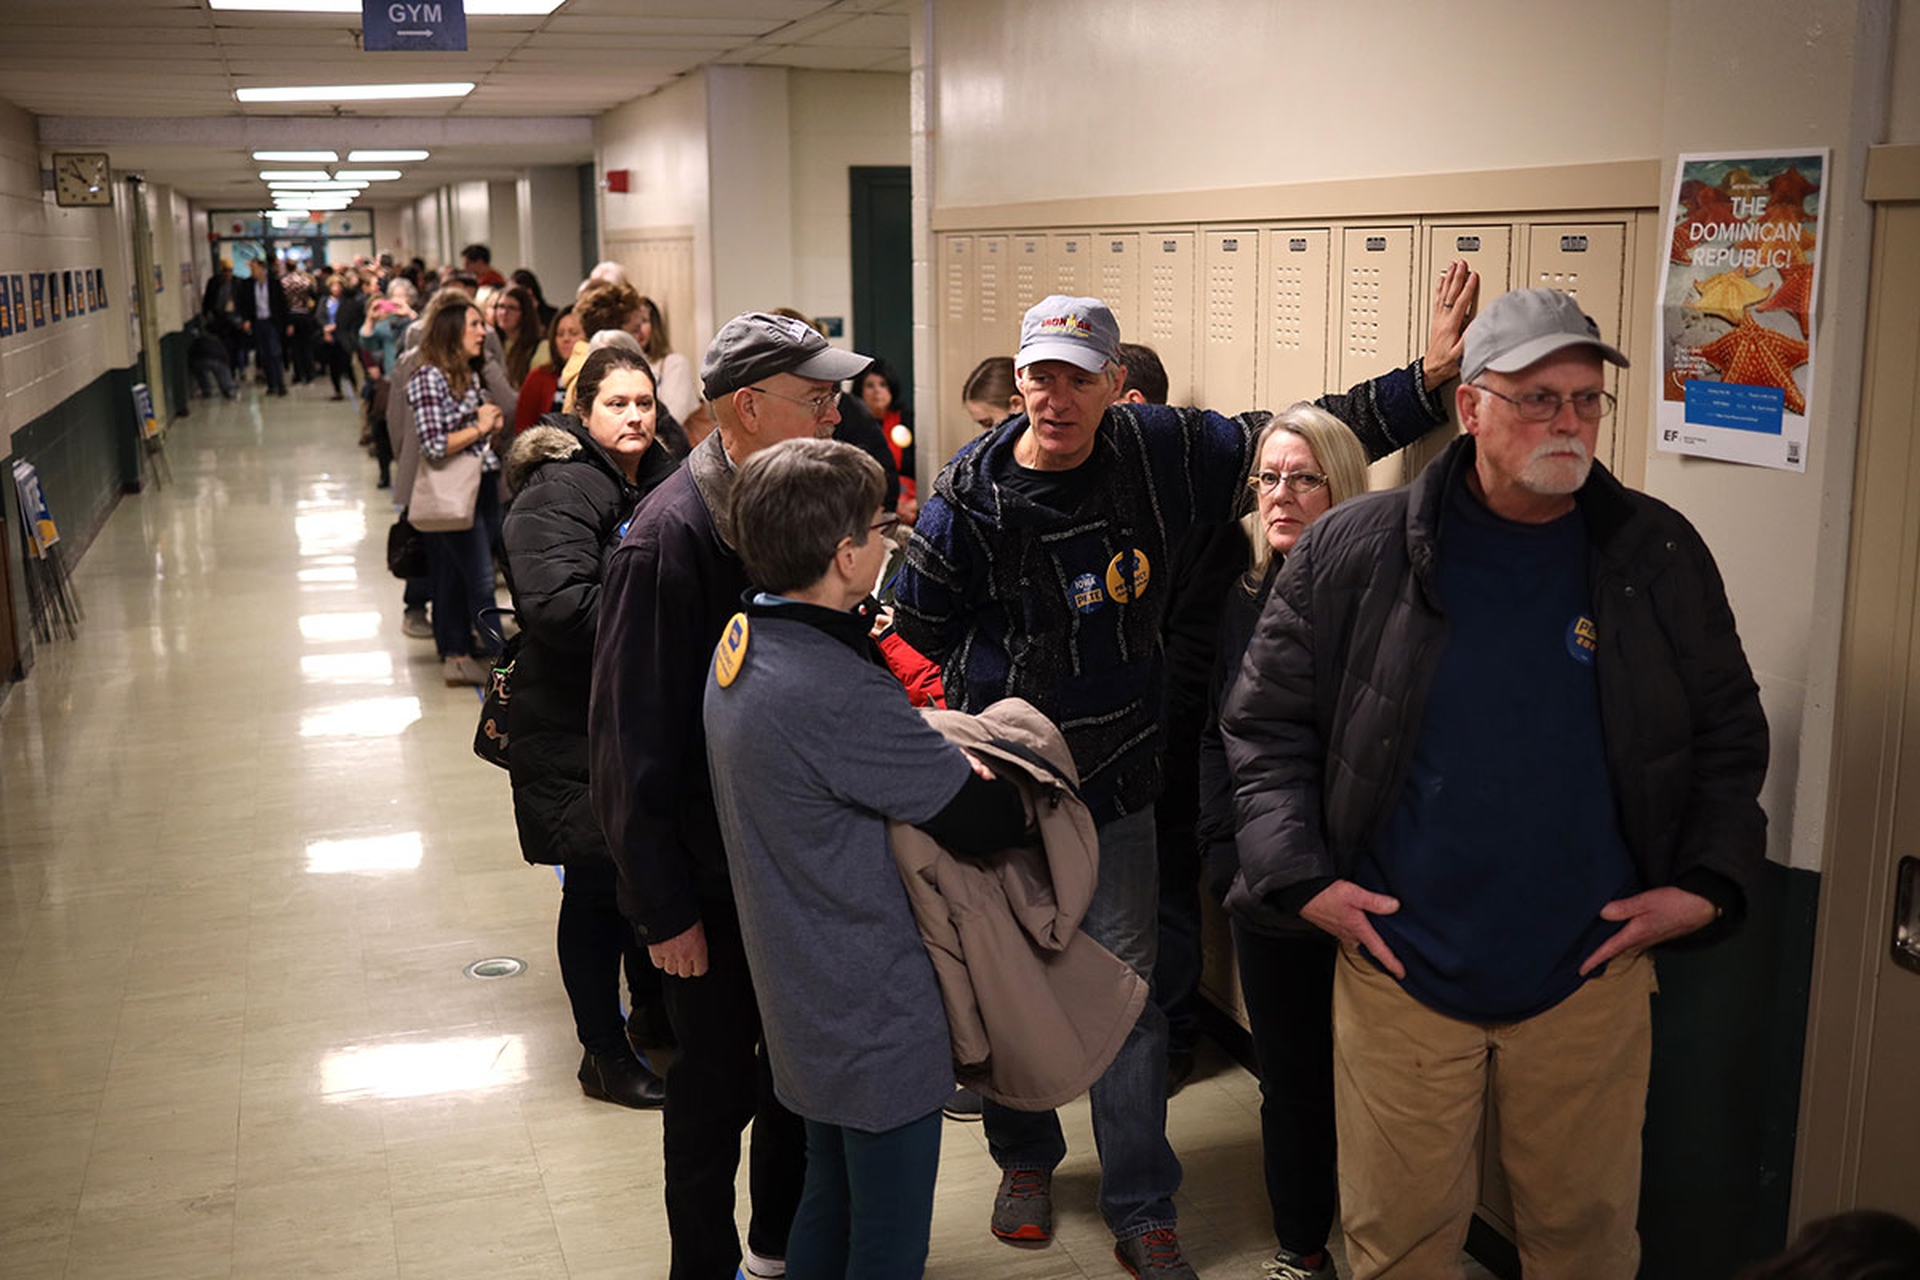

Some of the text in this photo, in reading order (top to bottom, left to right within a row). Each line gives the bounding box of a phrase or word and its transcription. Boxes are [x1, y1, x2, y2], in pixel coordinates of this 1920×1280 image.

[388, 3, 442, 23] GYM
[1730, 196, 1768, 217] THE
[1689, 222, 1802, 242] DOMINICAN
[1691, 247, 1792, 269] REPUBLIC!
[1663, 429, 1679, 442] EF
